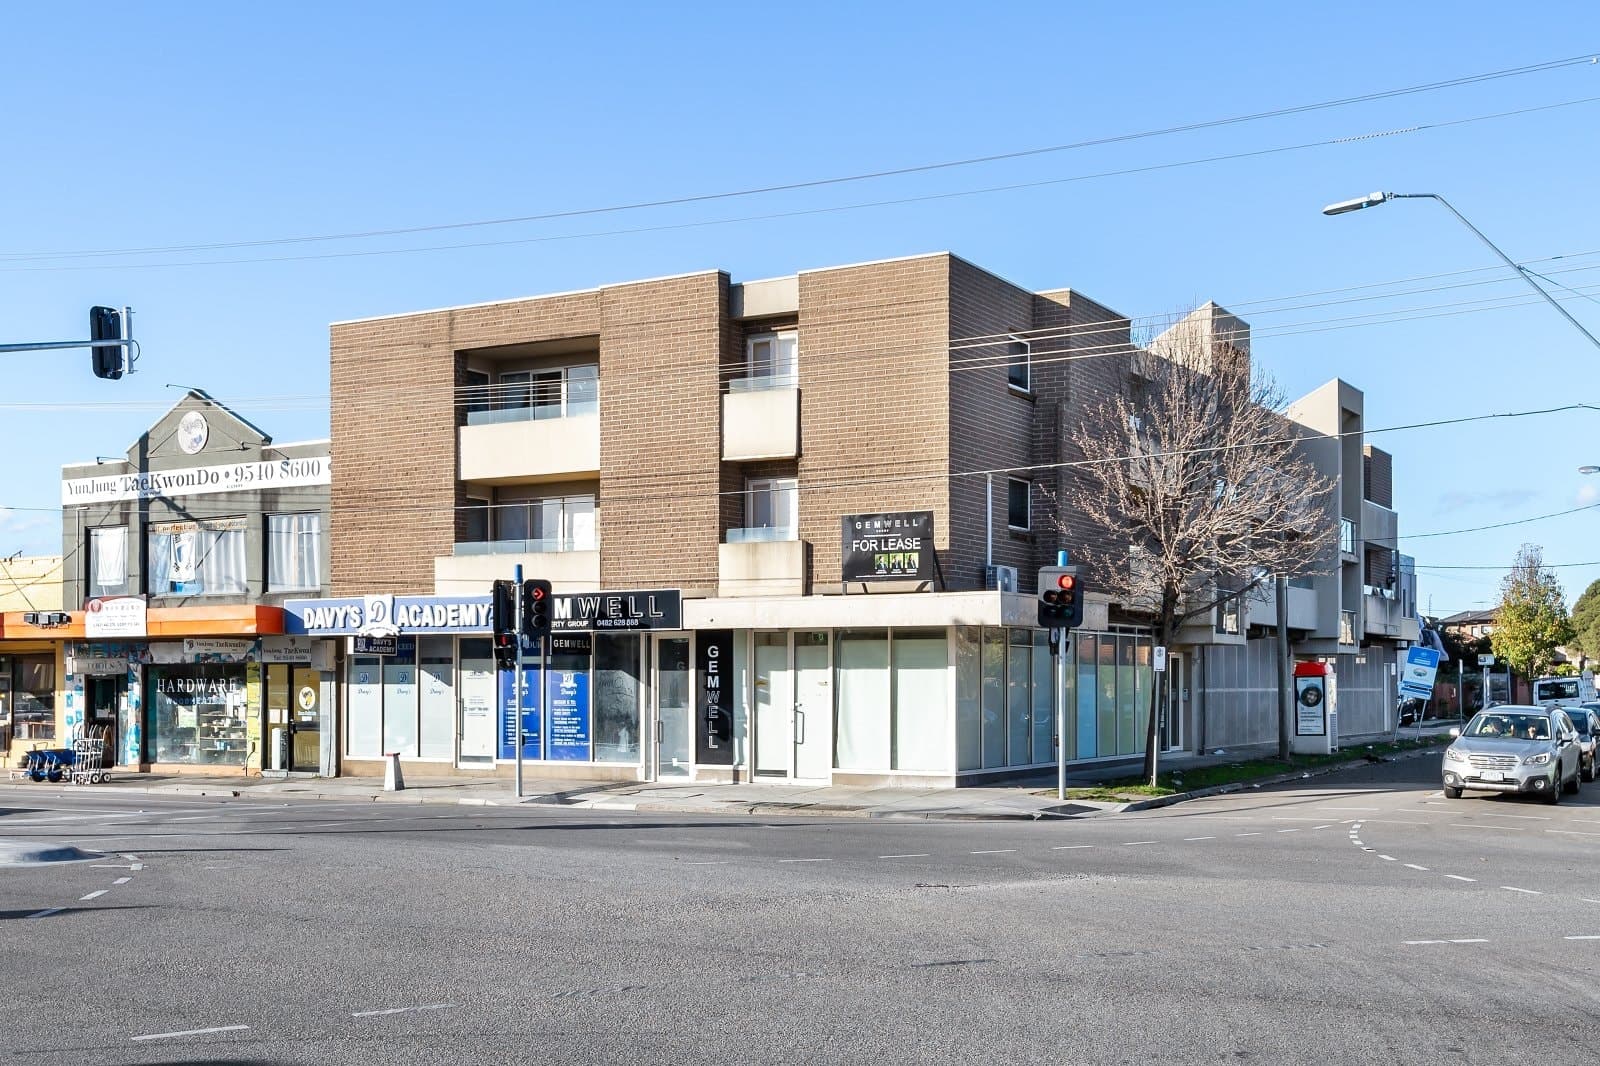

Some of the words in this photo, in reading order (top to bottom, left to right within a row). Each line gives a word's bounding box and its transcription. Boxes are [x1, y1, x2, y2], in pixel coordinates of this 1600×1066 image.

[67, 480, 117, 495] YunJung
[120, 468, 220, 492] TaeKwonDo
[235, 463, 274, 482] 9540
[280, 459, 321, 480] 8600
[855, 518, 919, 529] GEMWELL
[852, 540, 879, 552] FOR
[881, 537, 922, 551] LEASE
[553, 595, 664, 619] MWELL
[303, 606, 363, 630] DAVY'S
[396, 603, 491, 627] ACADEMY
[567, 620, 589, 628] GROUP
[596, 619, 613, 627] 0482
[613, 618, 625, 626] 628
[368, 645, 395, 654] ACADEMY
[372, 638, 393, 646] DAVY'S
[553, 639, 591, 648] GEMWELL
[156, 678, 237, 693] HARDWARE
[706, 645, 720, 749] GEMWELL
